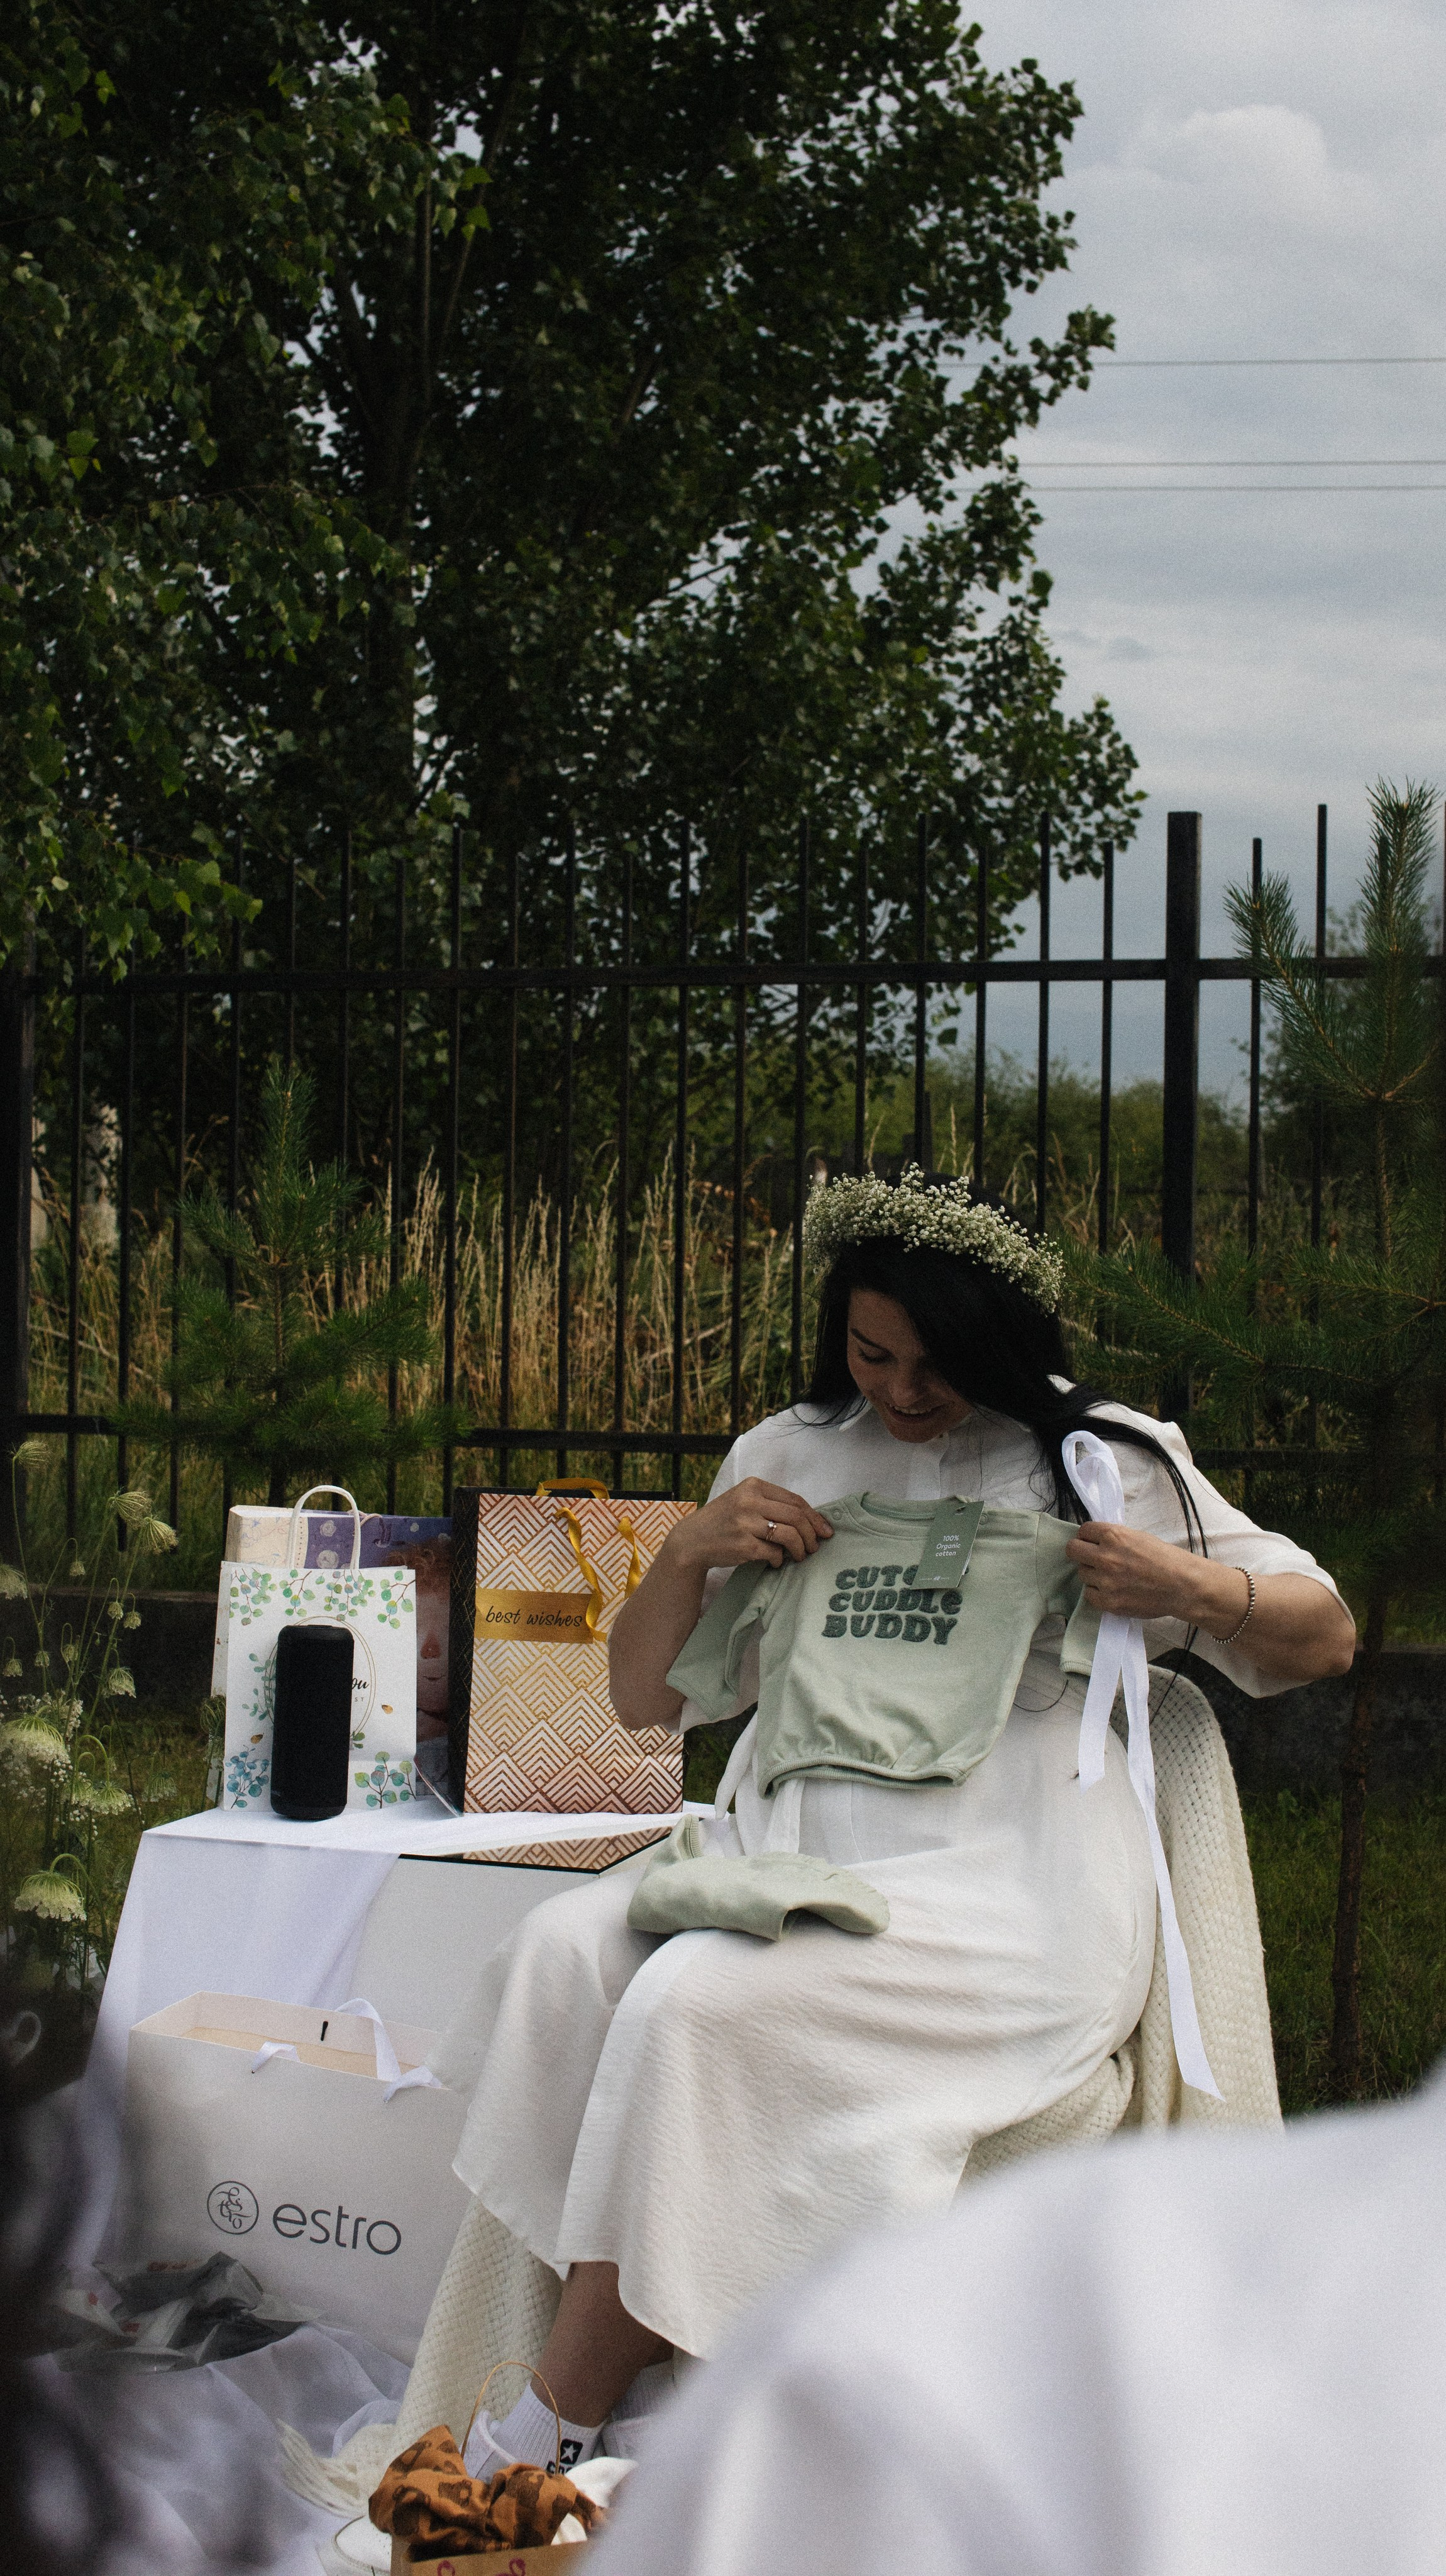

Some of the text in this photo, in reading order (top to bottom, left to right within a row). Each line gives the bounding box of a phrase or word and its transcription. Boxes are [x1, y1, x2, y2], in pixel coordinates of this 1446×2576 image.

[485, 1606, 583, 1627] best wishes
[821, 1613, 958, 1645] BUDDY
[272, 2203, 402, 2255] estro
